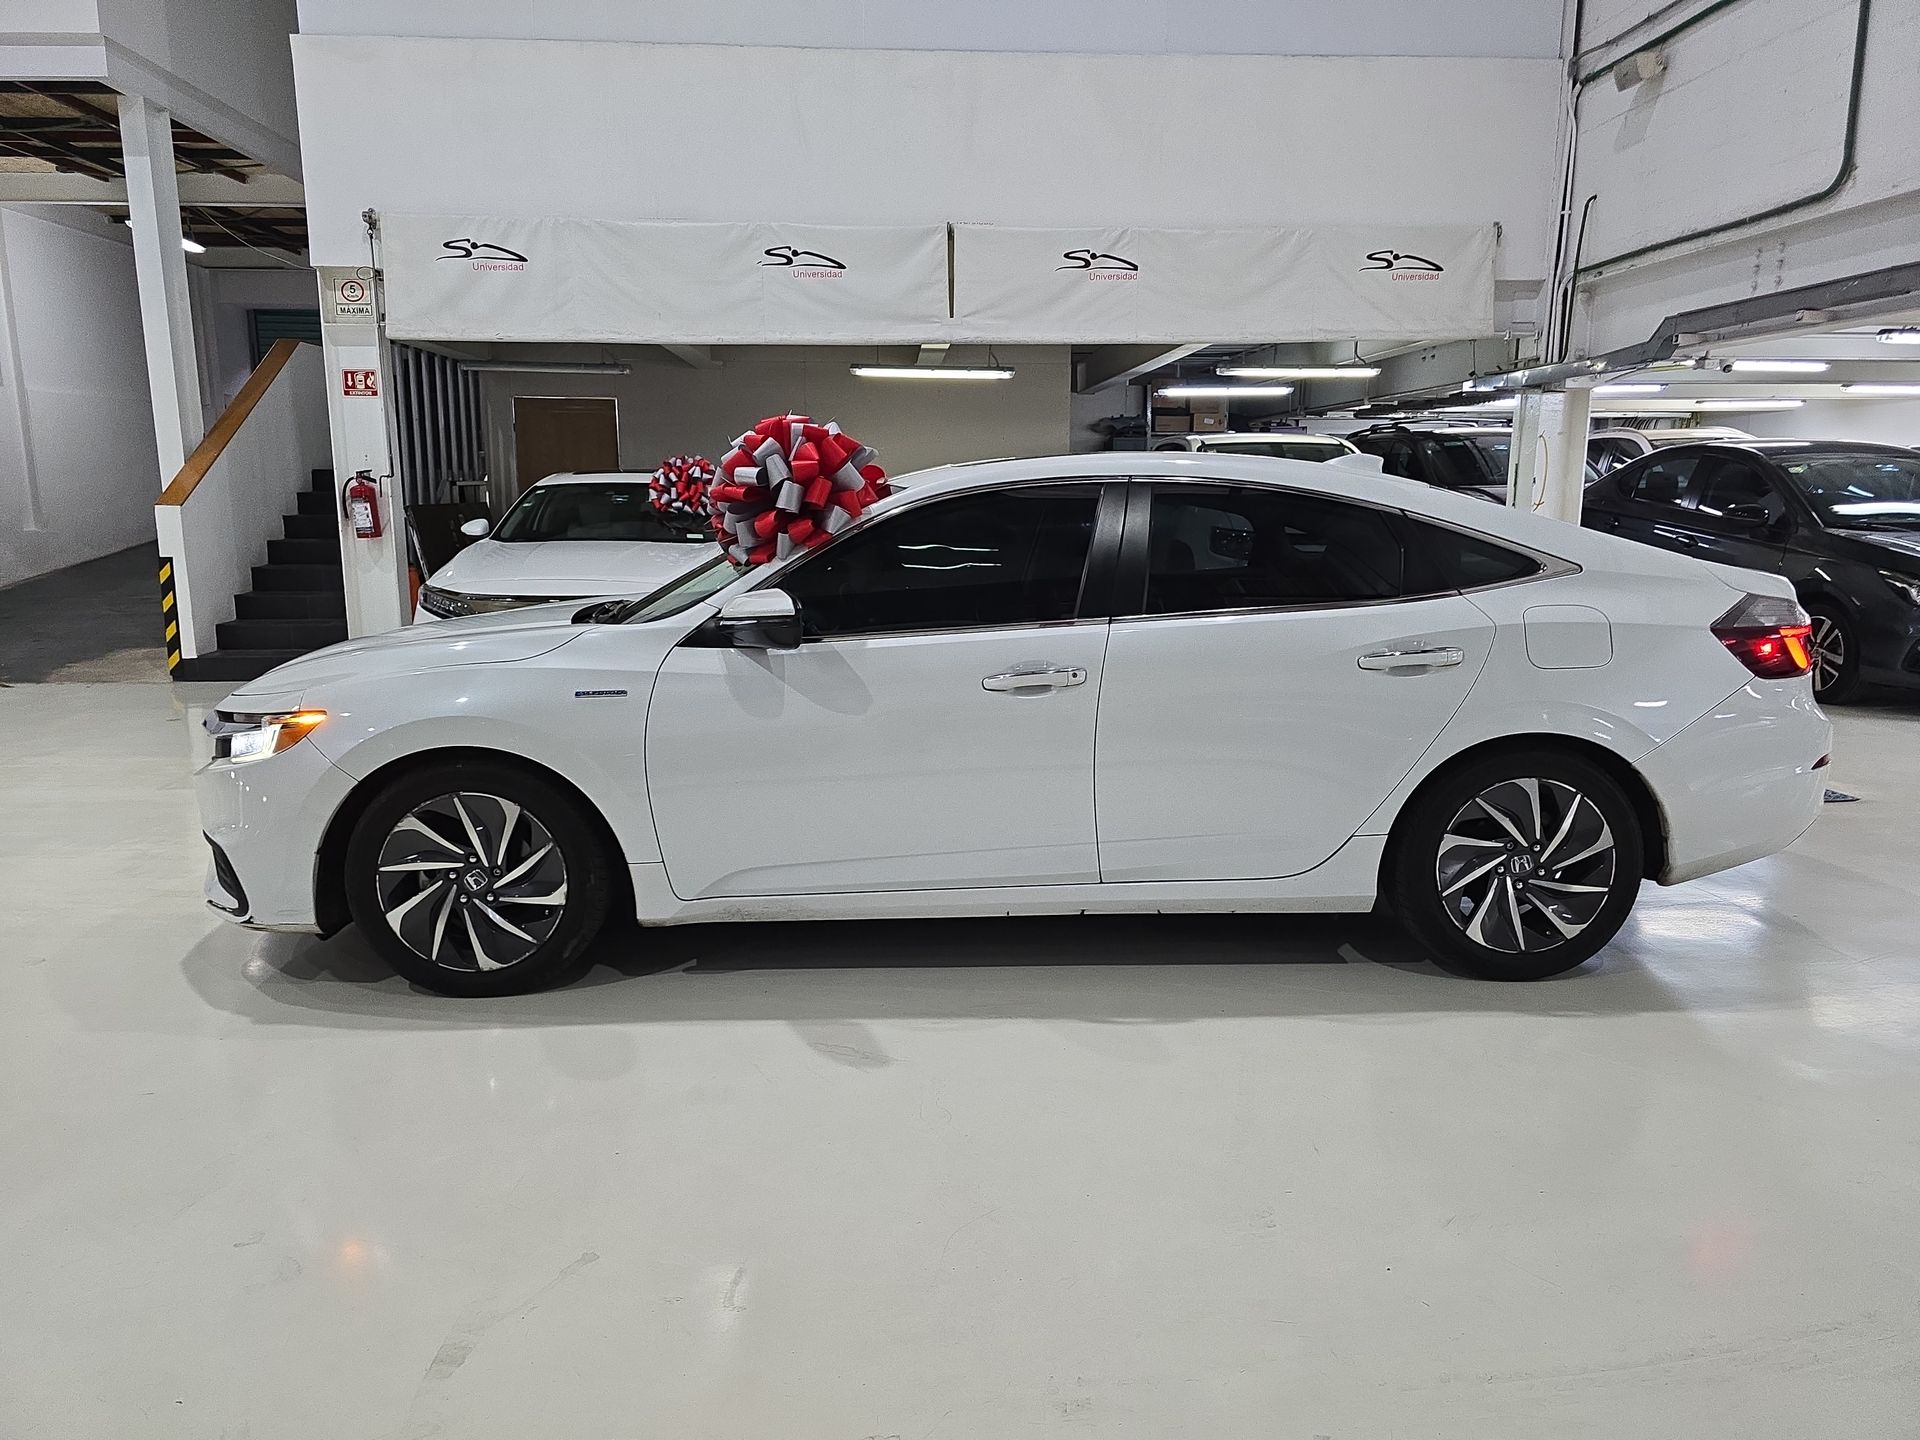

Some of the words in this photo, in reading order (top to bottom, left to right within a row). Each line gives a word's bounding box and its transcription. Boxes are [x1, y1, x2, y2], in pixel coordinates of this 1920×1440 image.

[472, 262, 524, 271] Universidad
[793, 270, 843, 278] Universidad
[1089, 273, 1138, 281] Universidad
[1391, 273, 1440, 281] Universidad
[349, 284, 356, 294] 5
